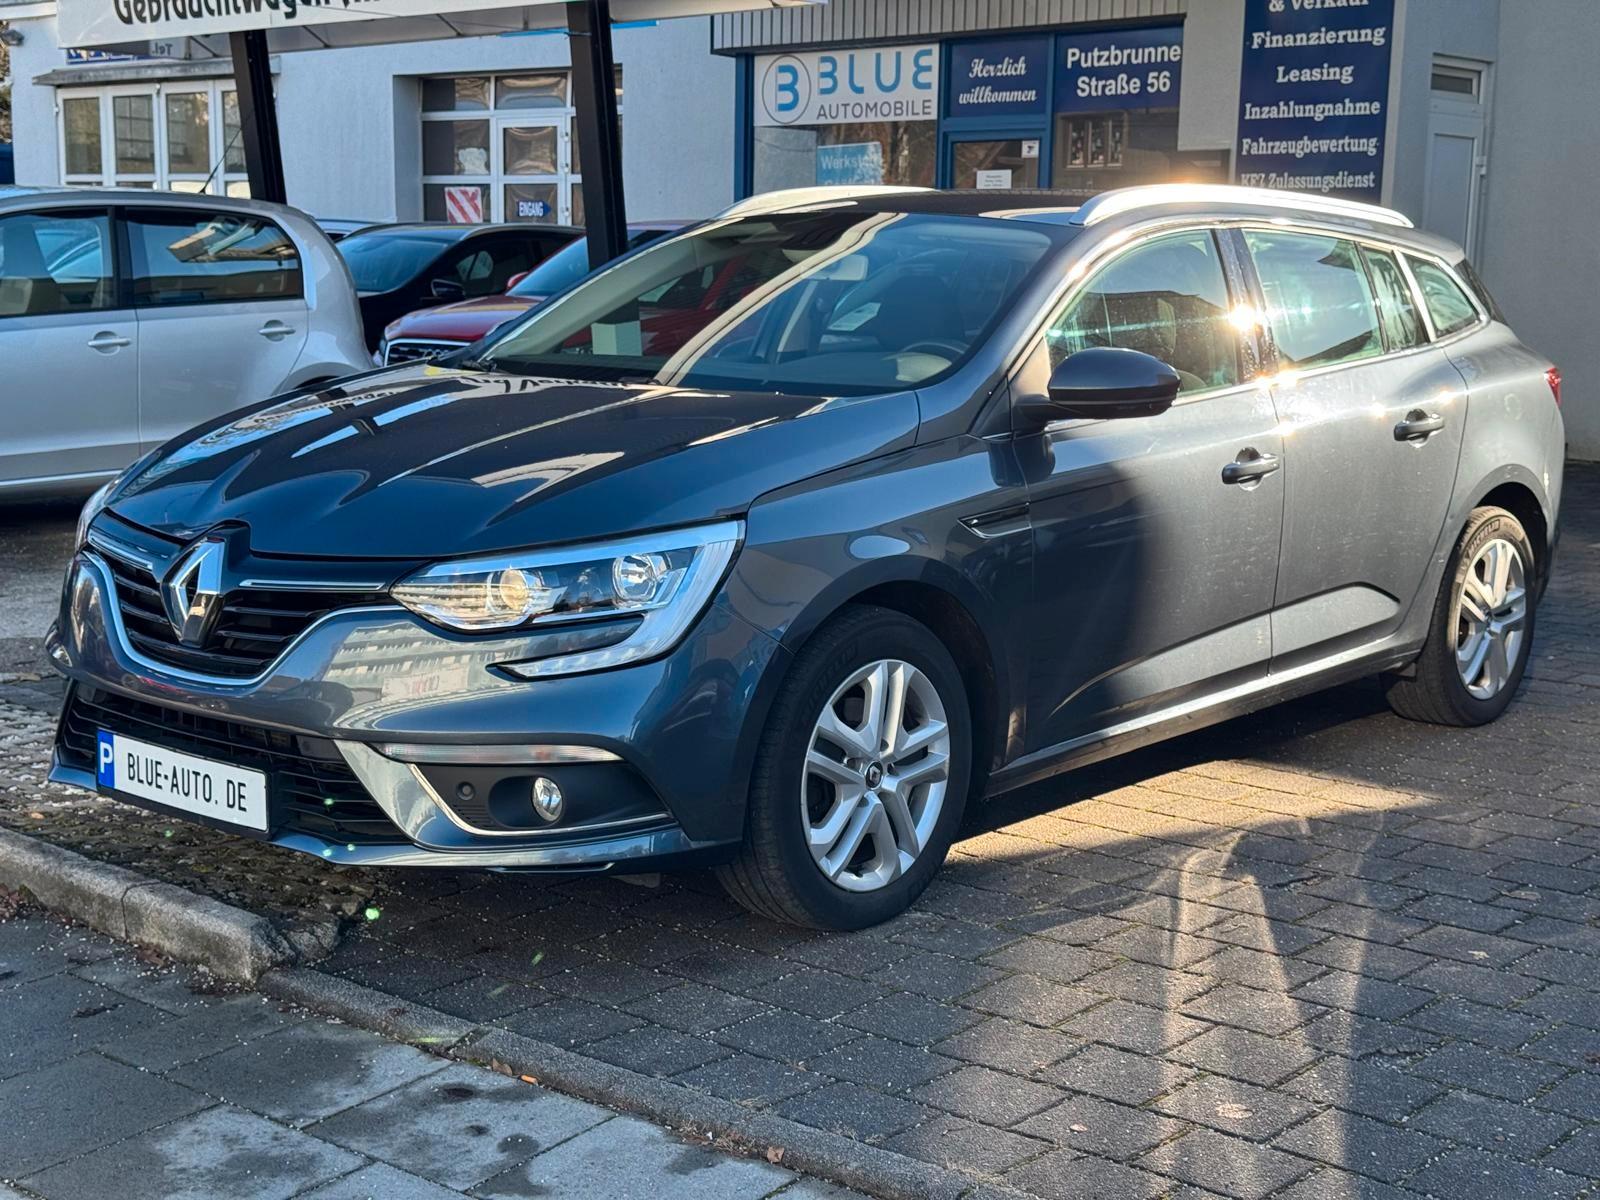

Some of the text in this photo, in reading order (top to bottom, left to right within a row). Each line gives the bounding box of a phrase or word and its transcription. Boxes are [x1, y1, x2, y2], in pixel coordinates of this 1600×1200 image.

[112, 0, 331, 24] Gebraucwg
[1268, 0, 1368, 12] & Verkau
[1251, 27, 1386, 49] Finanzierung
[817, 48, 933, 95] BLUE
[969, 56, 1027, 78] Herzlich
[1276, 63, 1354, 84] Leasing
[959, 86, 1037, 104] willkommen
[1076, 71, 1171, 97] Straße 56
[816, 99, 932, 120] AUTOMOBILE
[1244, 98, 1381, 121] Inzahlungnahme
[1241, 135, 1378, 158] Fahrzeugbewertung
[1241, 171, 1375, 192] KFZ Zulassungsdienst
[519, 201, 544, 217] EINGANG
[100, 741, 114, 774] P
